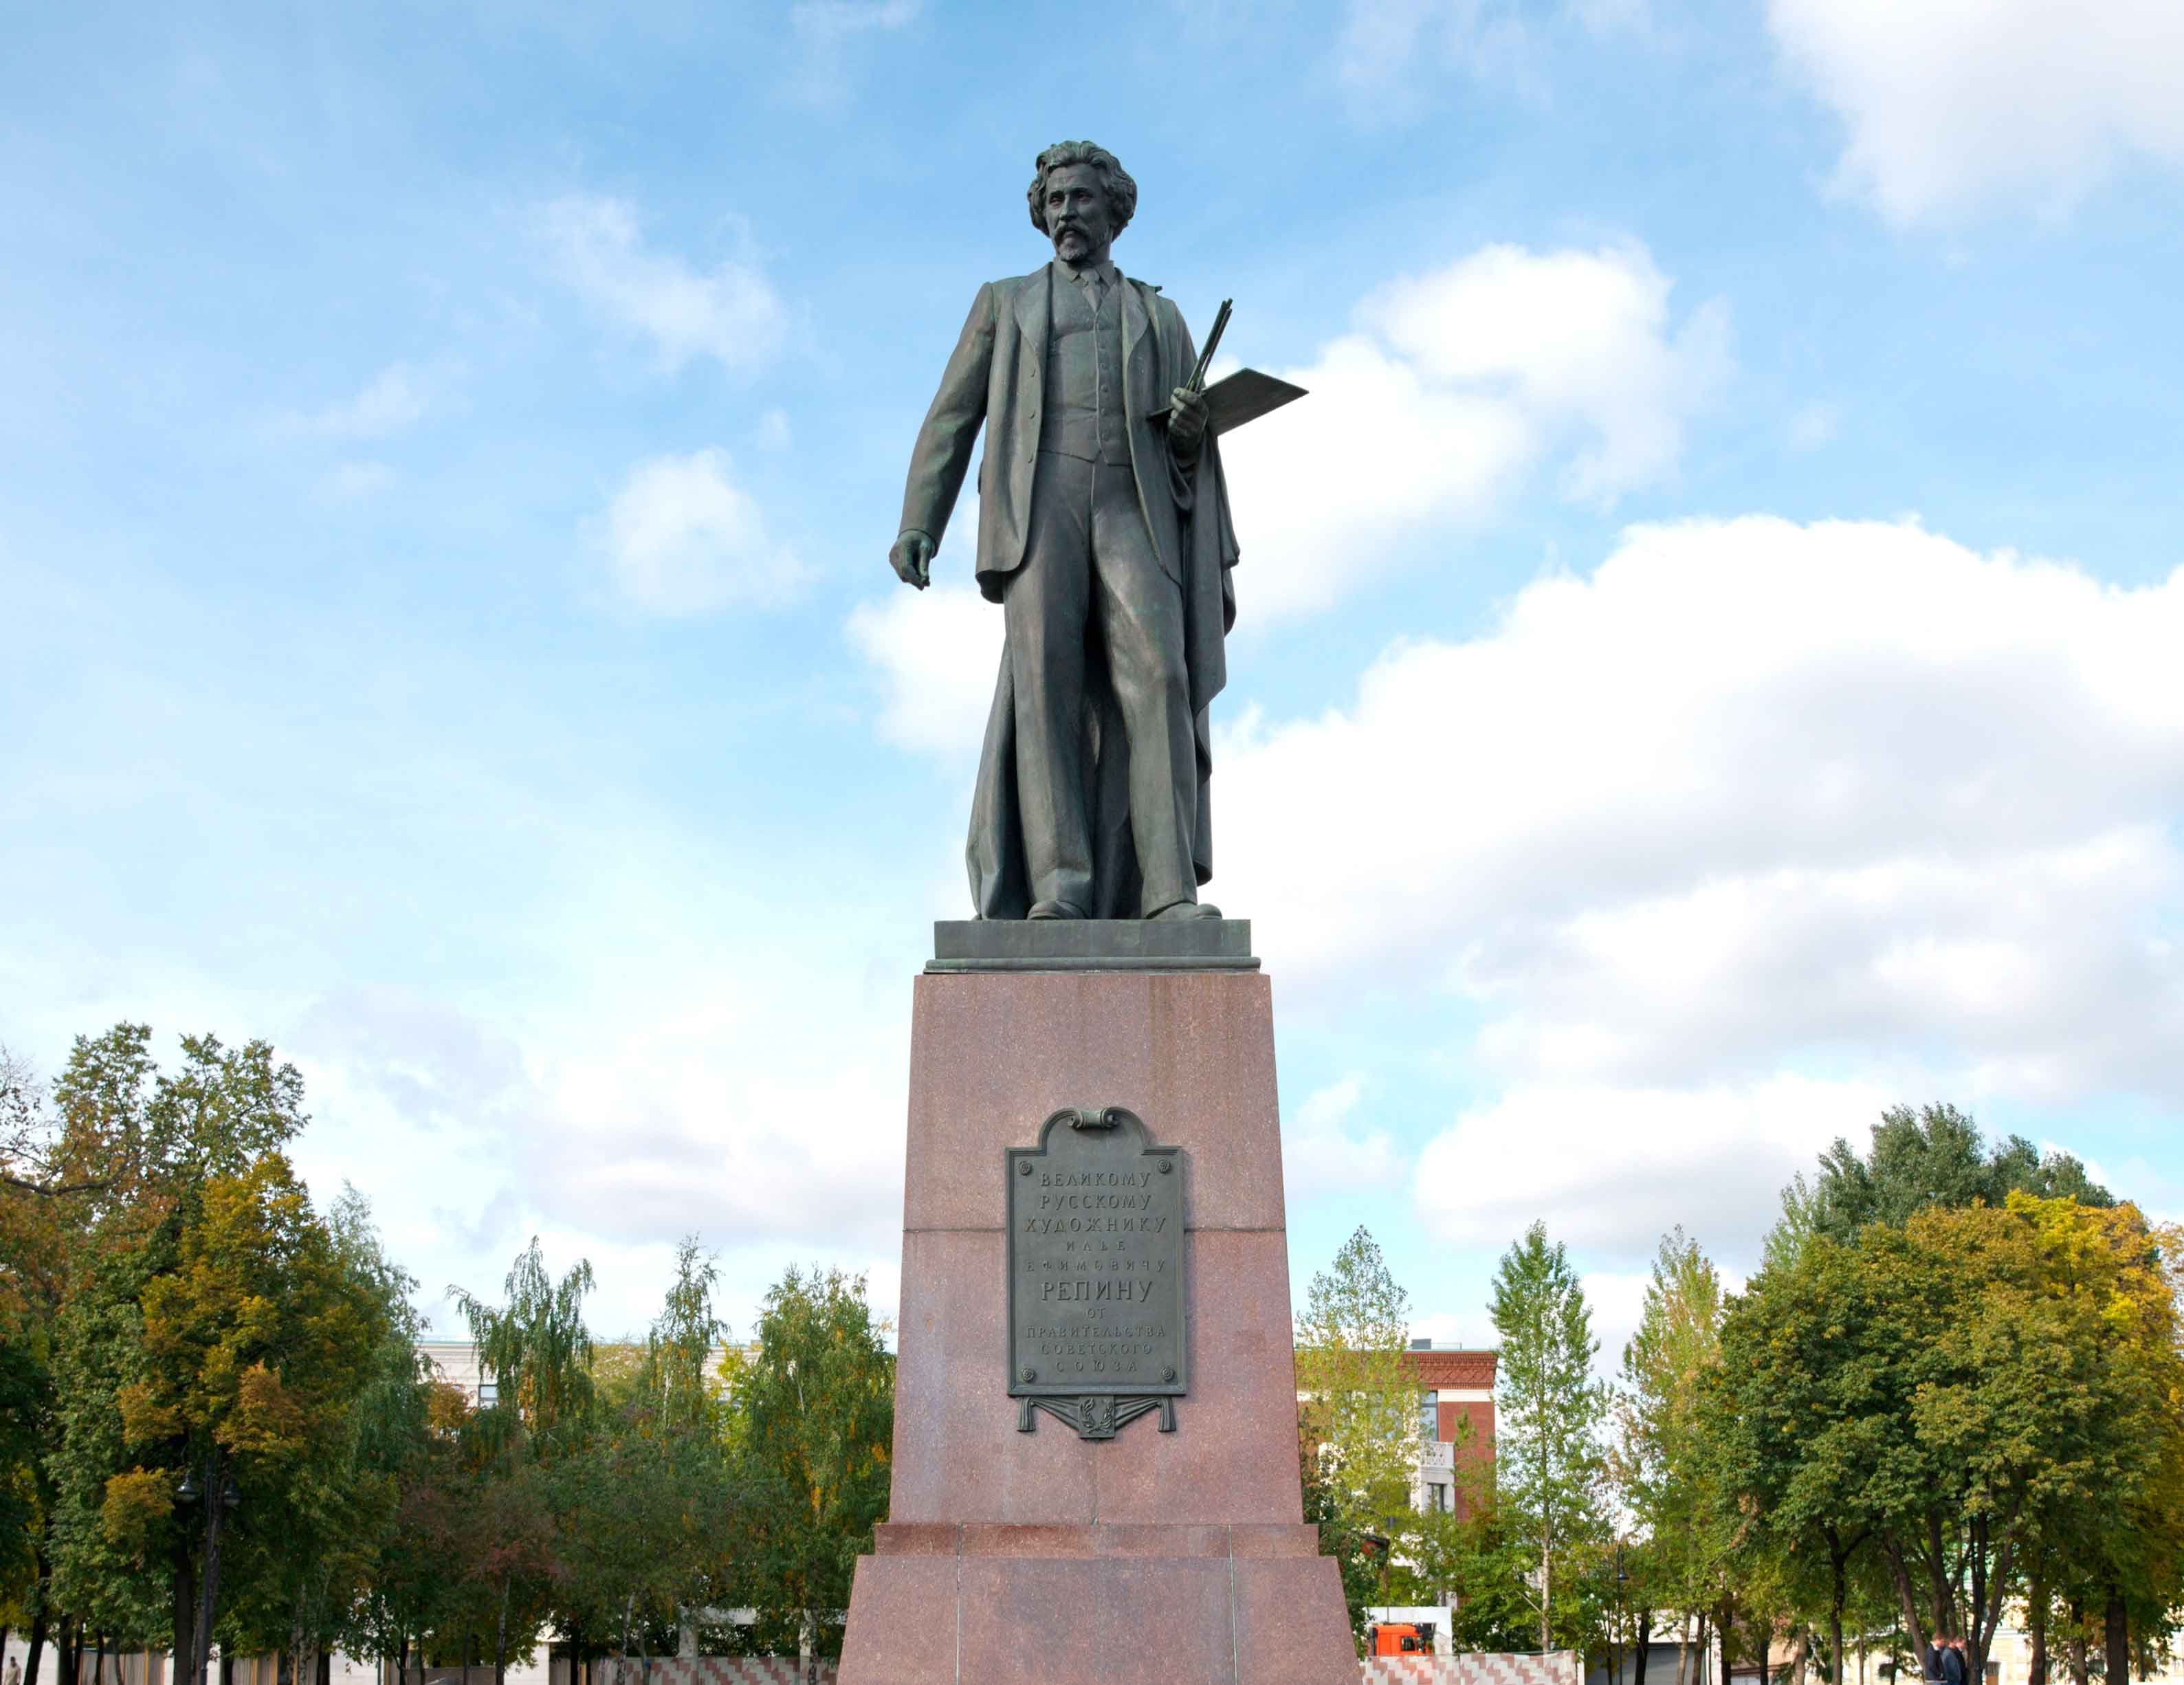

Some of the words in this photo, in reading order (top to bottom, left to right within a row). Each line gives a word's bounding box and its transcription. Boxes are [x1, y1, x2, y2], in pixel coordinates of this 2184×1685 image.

[1041, 1172, 1150, 1187] ВЕЛИКОМУ
[1041, 1194, 1151, 1210] РУССКОМУ
[1025, 1216, 1167, 1233] ХУДОЖНИКУ
[1066, 1240, 1127, 1252] ИЛЬЕ
[1027, 1259, 1166, 1273] ЕФИМОВИЧУ
[1041, 1281, 1152, 1301] РЕПИНУ
[1087, 1308, 1105, 1319] ОТ
[1026, 1325, 1166, 1339] ПРАВИТЕЛЬСТВА
[1041, 1343, 1152, 1355] СОВЕТСКОГО
[1056, 1360, 1138, 1372] СОЮЗА
